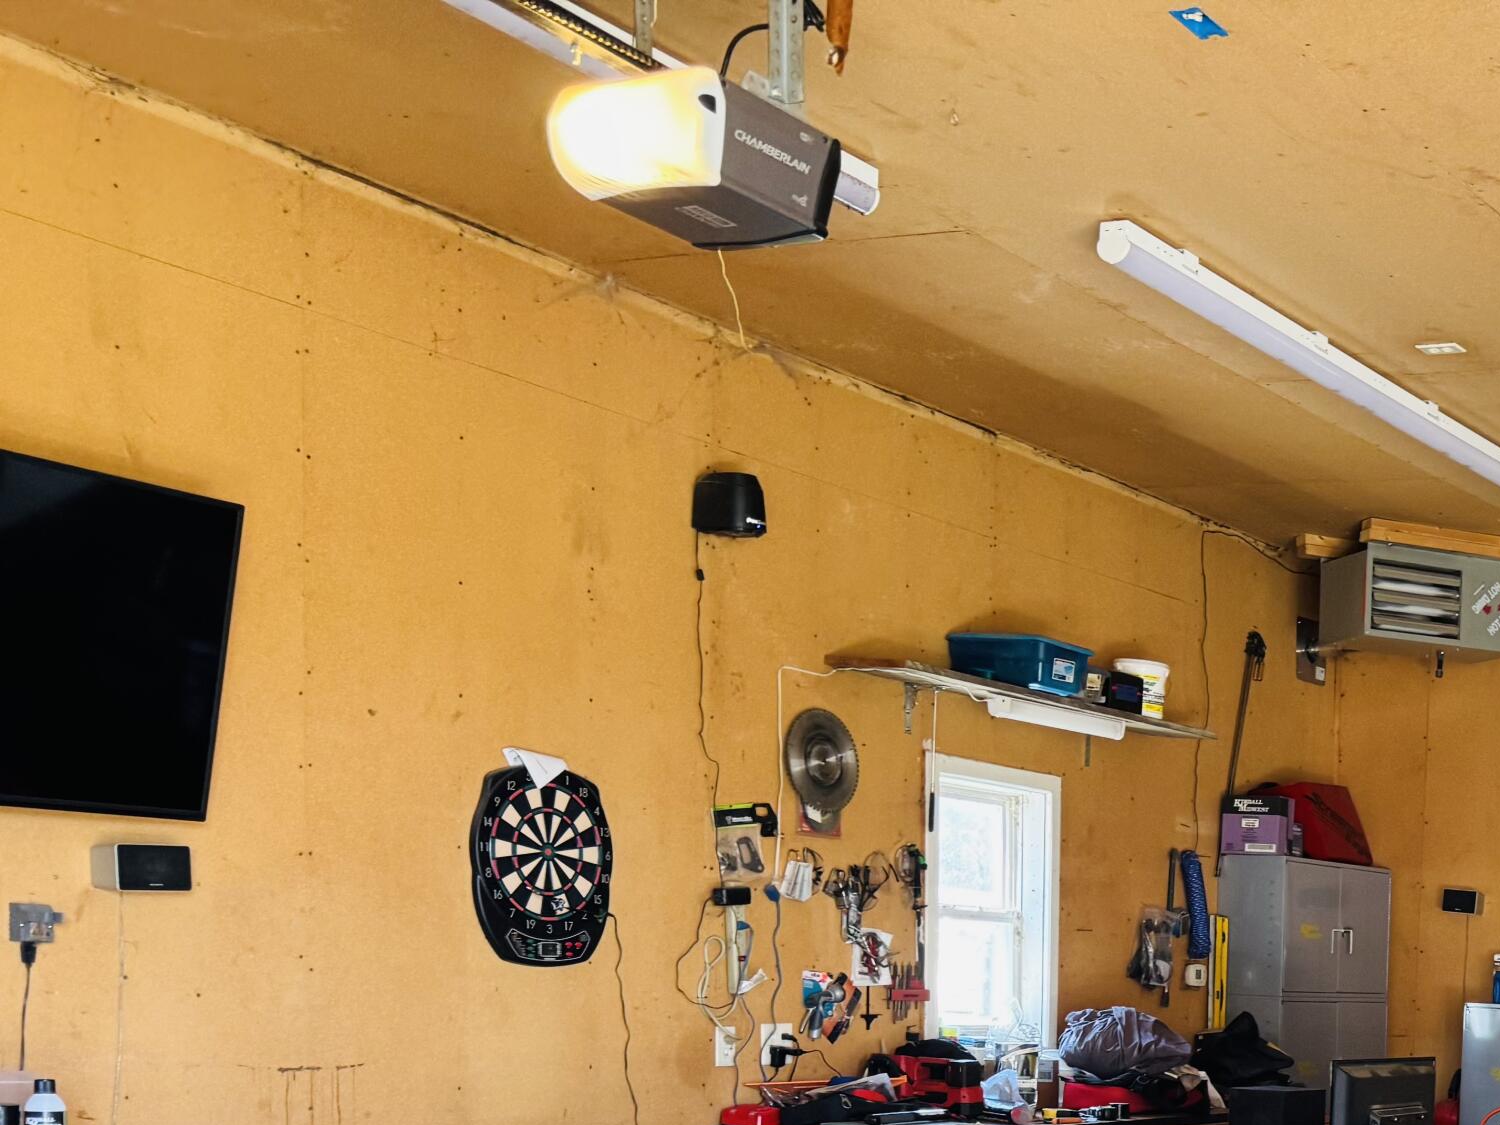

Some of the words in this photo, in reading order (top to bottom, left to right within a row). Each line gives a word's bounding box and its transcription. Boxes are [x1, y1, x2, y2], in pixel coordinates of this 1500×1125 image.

[734, 129, 811, 175] CHAMBERLAIN
[507, 780, 516, 791] 12
[565, 775, 570, 786] 1
[579, 787, 588, 797] 18
[494, 796, 501, 807] 9
[594, 805, 600, 816] 4
[484, 816, 493, 827] 14
[600, 827, 609, 838] 13
[480, 841, 489, 852] 11
[605, 851, 611, 861] 6
[485, 868, 492, 878] 8
[602, 873, 610, 884] 10
[494, 890, 502, 900] 16
[594, 894, 603, 905] 15
[510, 908, 516, 918] 7
[582, 910, 588, 920] 2
[526, 919, 536, 929] 19
[547, 924, 553, 934] 3
[565, 921, 573, 931] 17
